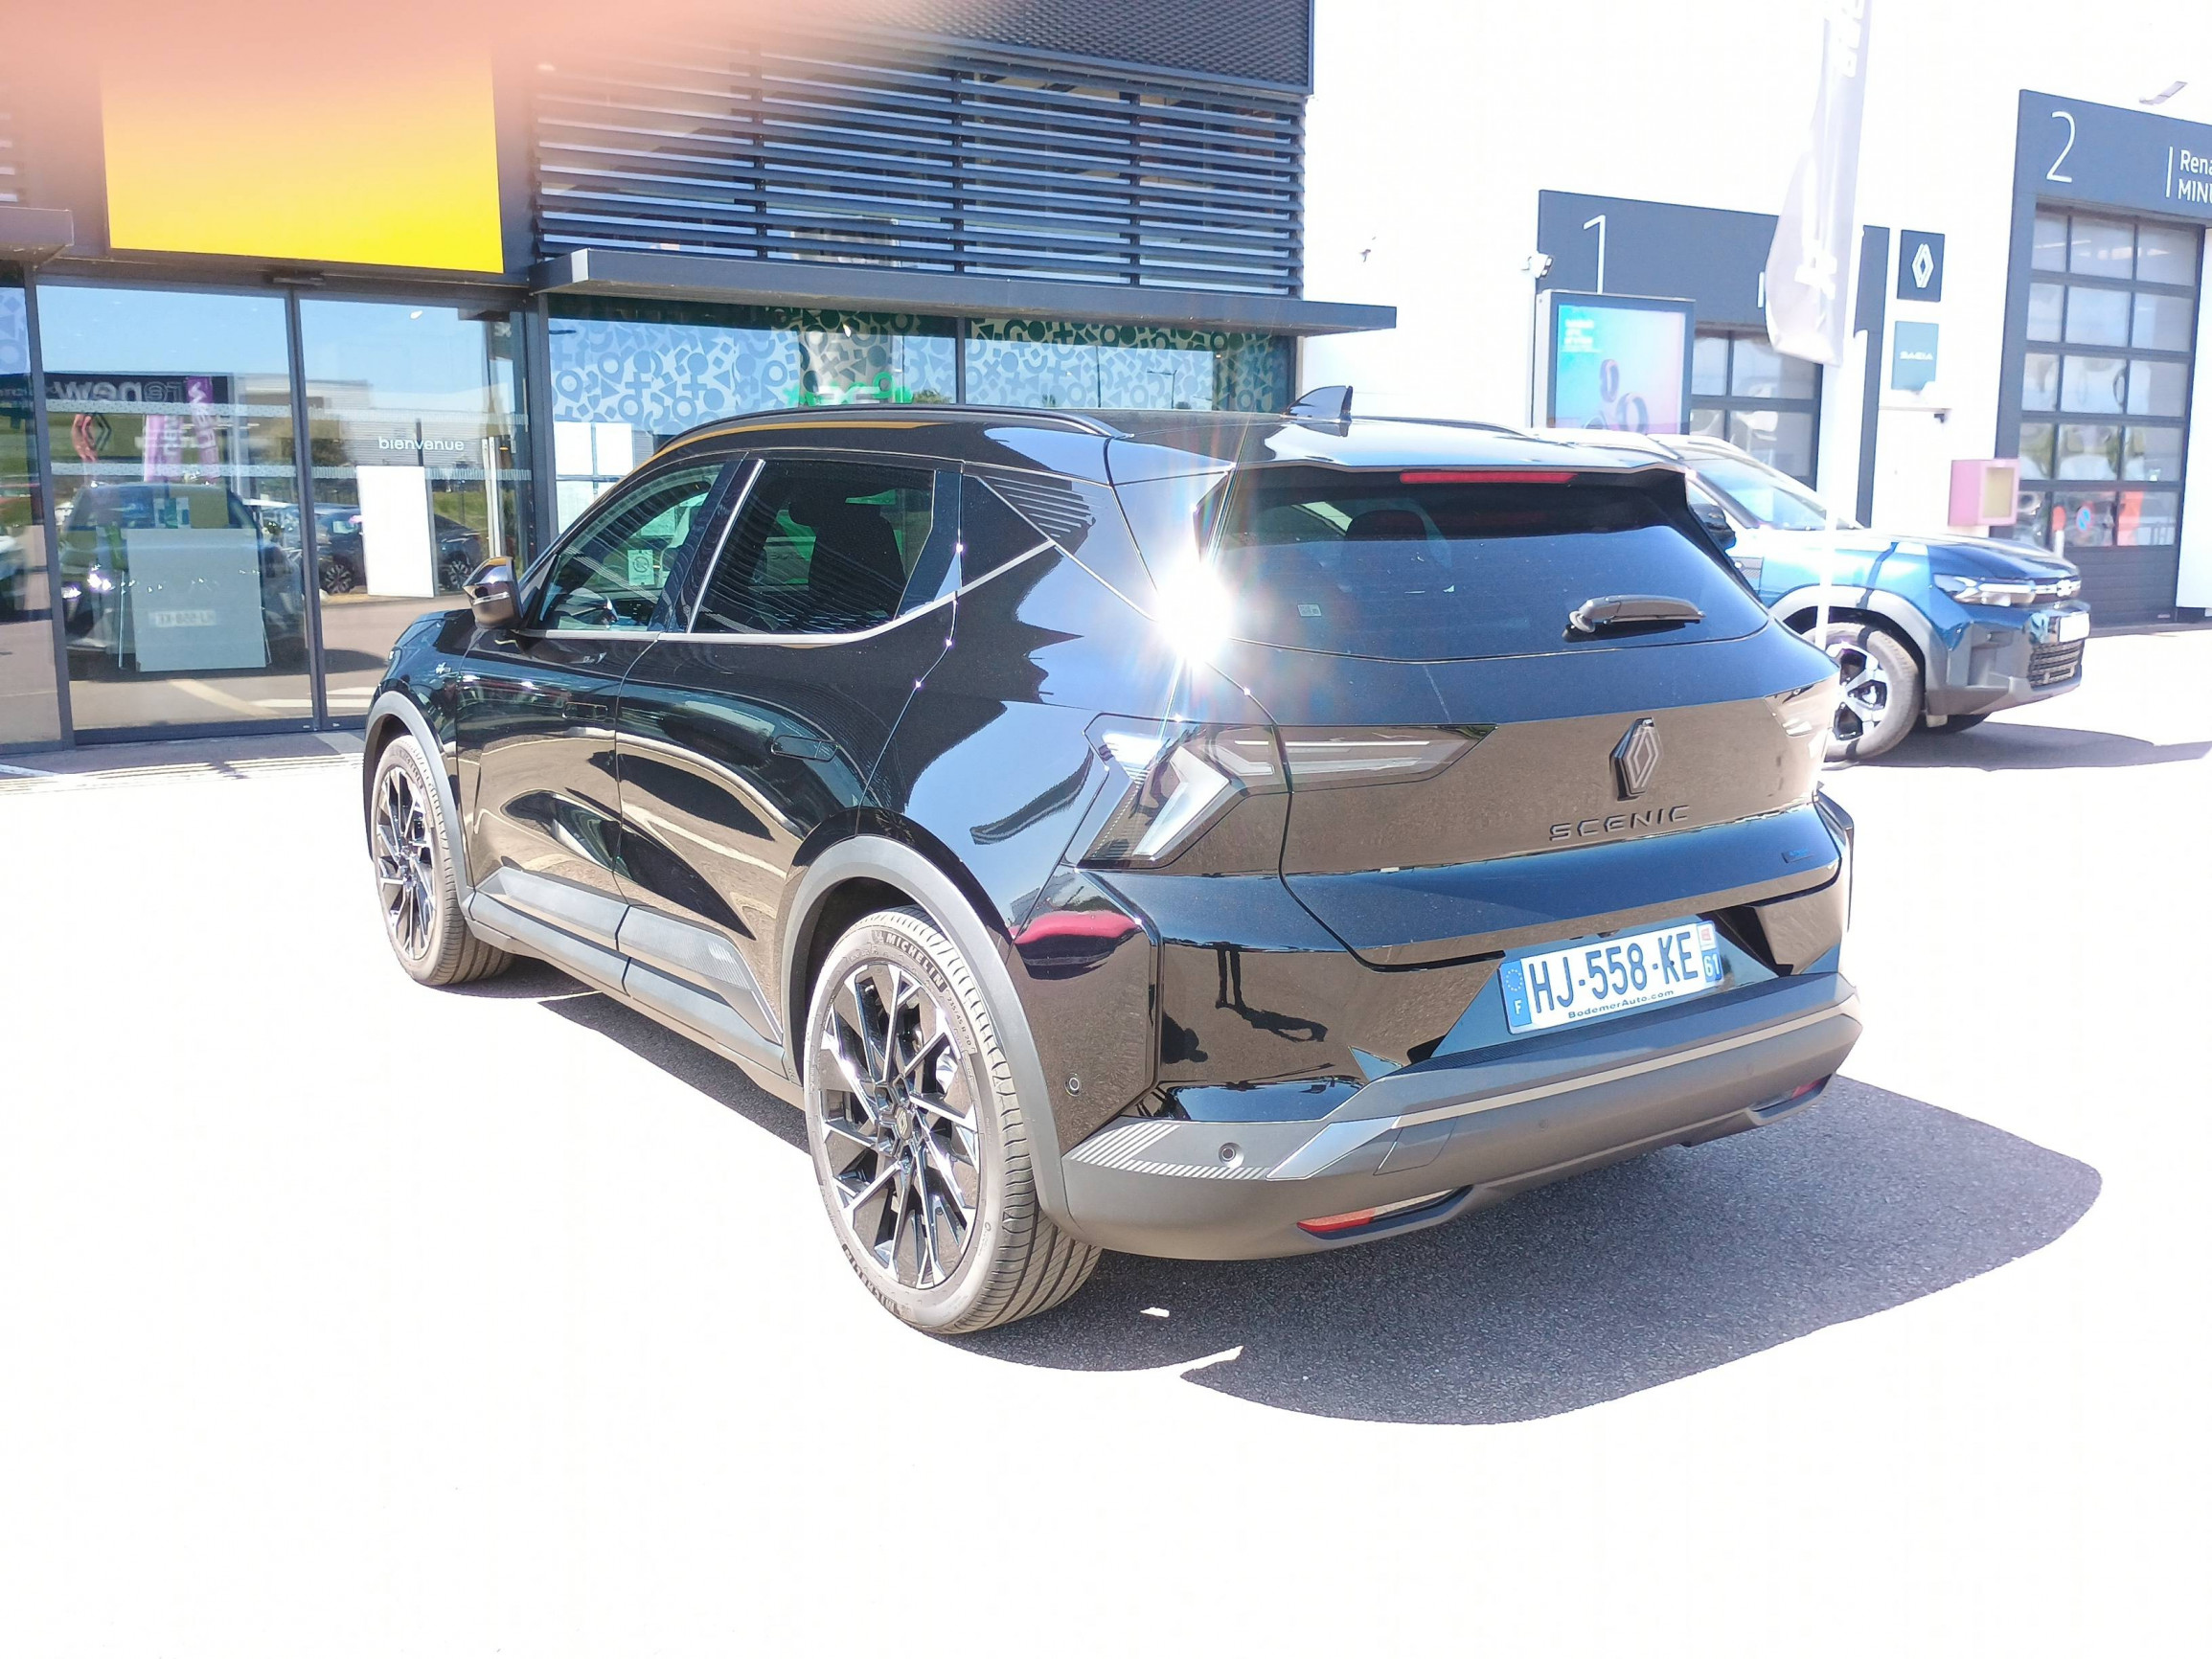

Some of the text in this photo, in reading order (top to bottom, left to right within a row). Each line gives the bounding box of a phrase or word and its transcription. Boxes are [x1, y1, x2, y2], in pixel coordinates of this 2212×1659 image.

[2046, 111, 2076, 183] 2
[2178, 178, 2212, 204] MIN
[1583, 214, 1606, 294] 1
[378, 436, 465, 451] bienvenue
[1549, 806, 1689, 841] SCENIC
[885, 932, 945, 988] MICHELIN
[1514, 931, 1722, 1015] F HJ-558-KE 61
[1568, 989, 1675, 1019] BodemerAuto.com
